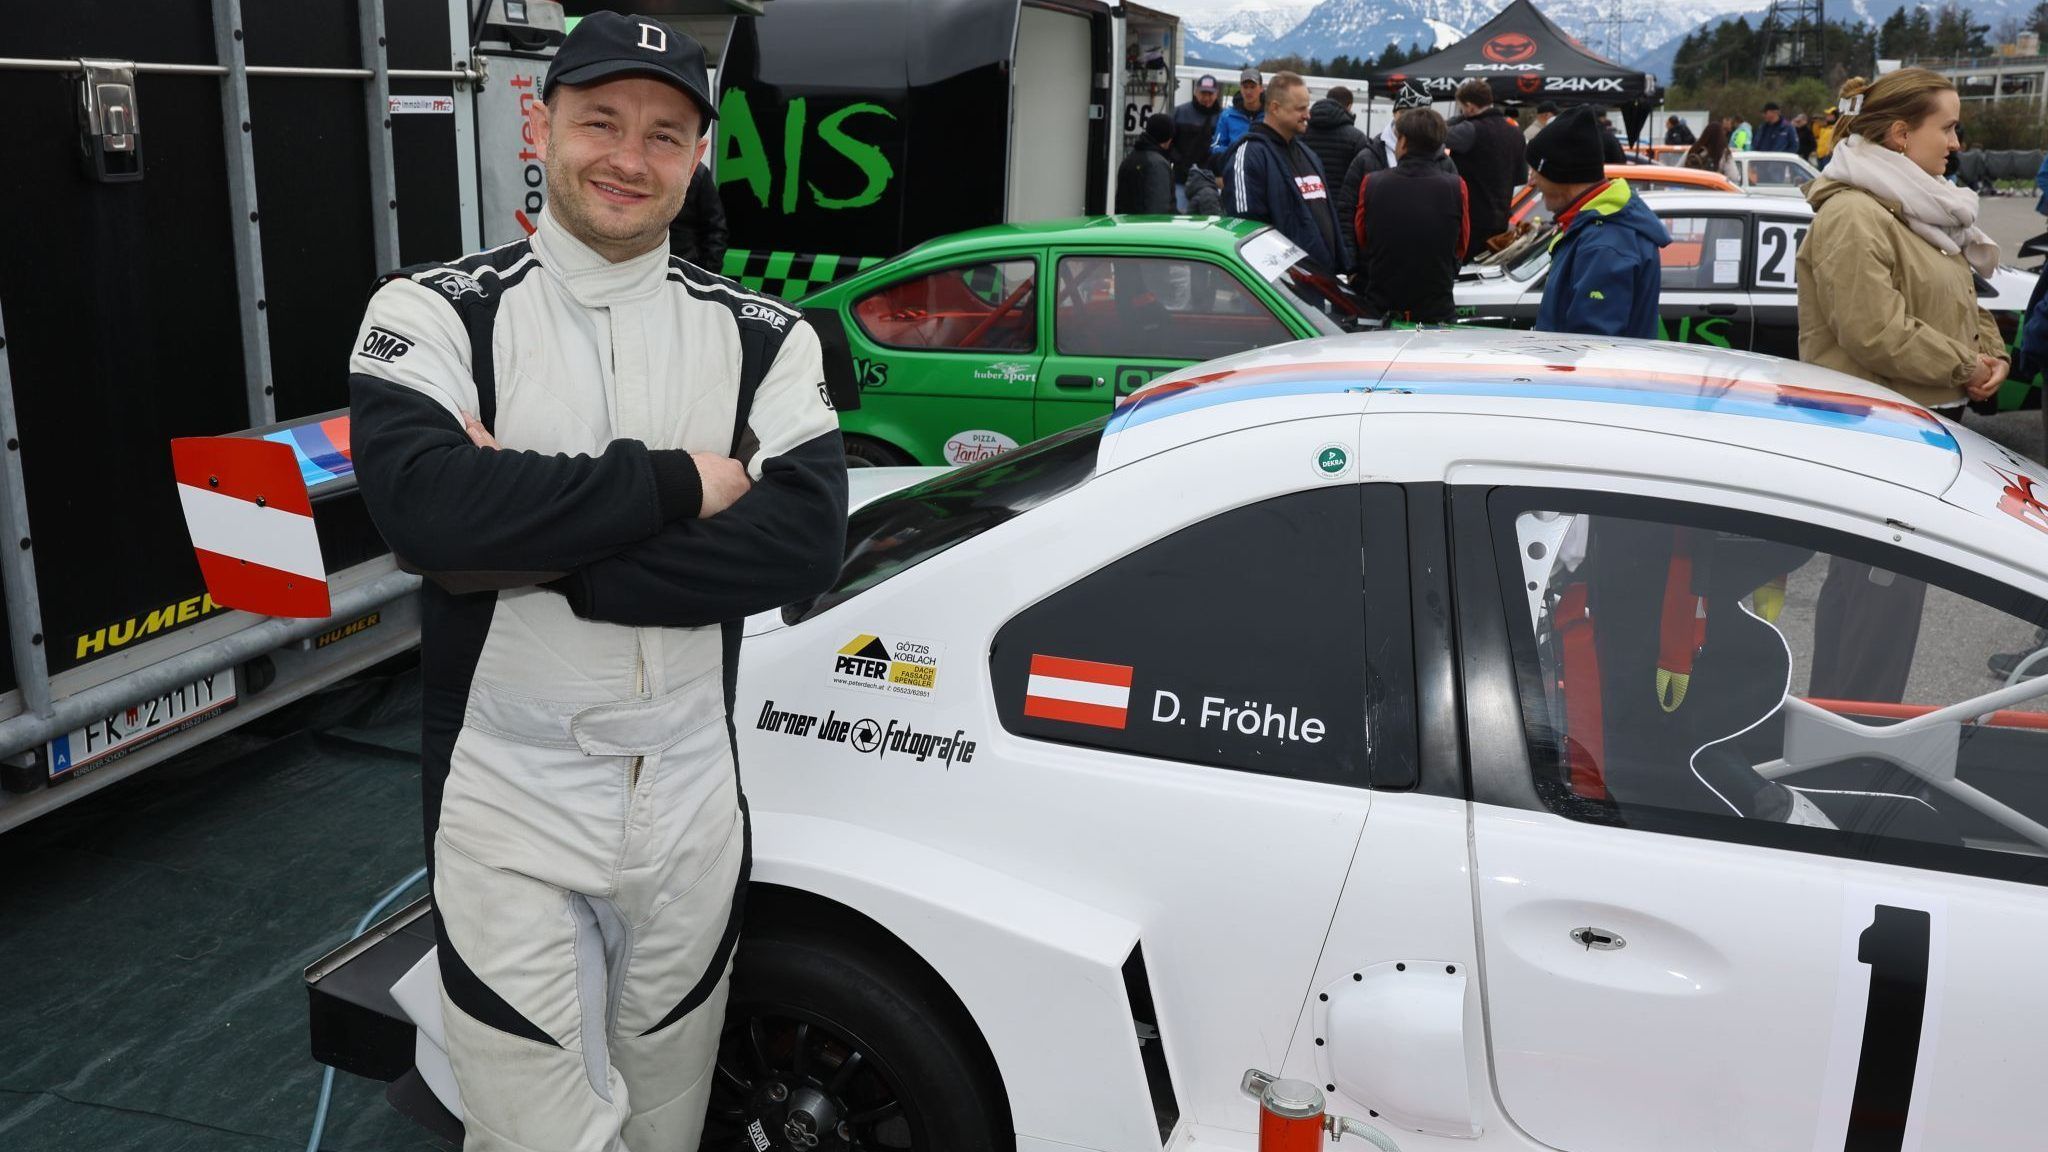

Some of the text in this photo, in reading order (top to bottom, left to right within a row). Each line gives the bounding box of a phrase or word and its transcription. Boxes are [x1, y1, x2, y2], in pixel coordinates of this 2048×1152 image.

[638, 23, 666, 52] D
[1463, 63, 1547, 72] 24MX
[1416, 76, 1488, 92] 24M
[1544, 77, 1625, 92] 24MX
[741, 304, 787, 327] OMP
[363, 331, 409, 361] OMP
[973, 434, 997, 443] PIZZA
[1322, 458, 1345, 468] DEKRA
[320, 614, 378, 646] HUMER
[896, 641, 930, 655] GÖTZIS
[894, 652, 937, 666] KOBLACH
[835, 655, 888, 680] PETER
[914, 666, 934, 675] DACH
[894, 676, 932, 688] SPENGLER
[901, 671, 933, 681] FASSADE
[833, 678, 885, 691] www.peterdach.at
[756, 700, 817, 737] Dorner
[818, 710, 850, 743] Joe
[1152, 690, 1326, 744] D. Fröhle
[57, 754, 67, 766] A
[1844, 903, 1931, 1152] 1
